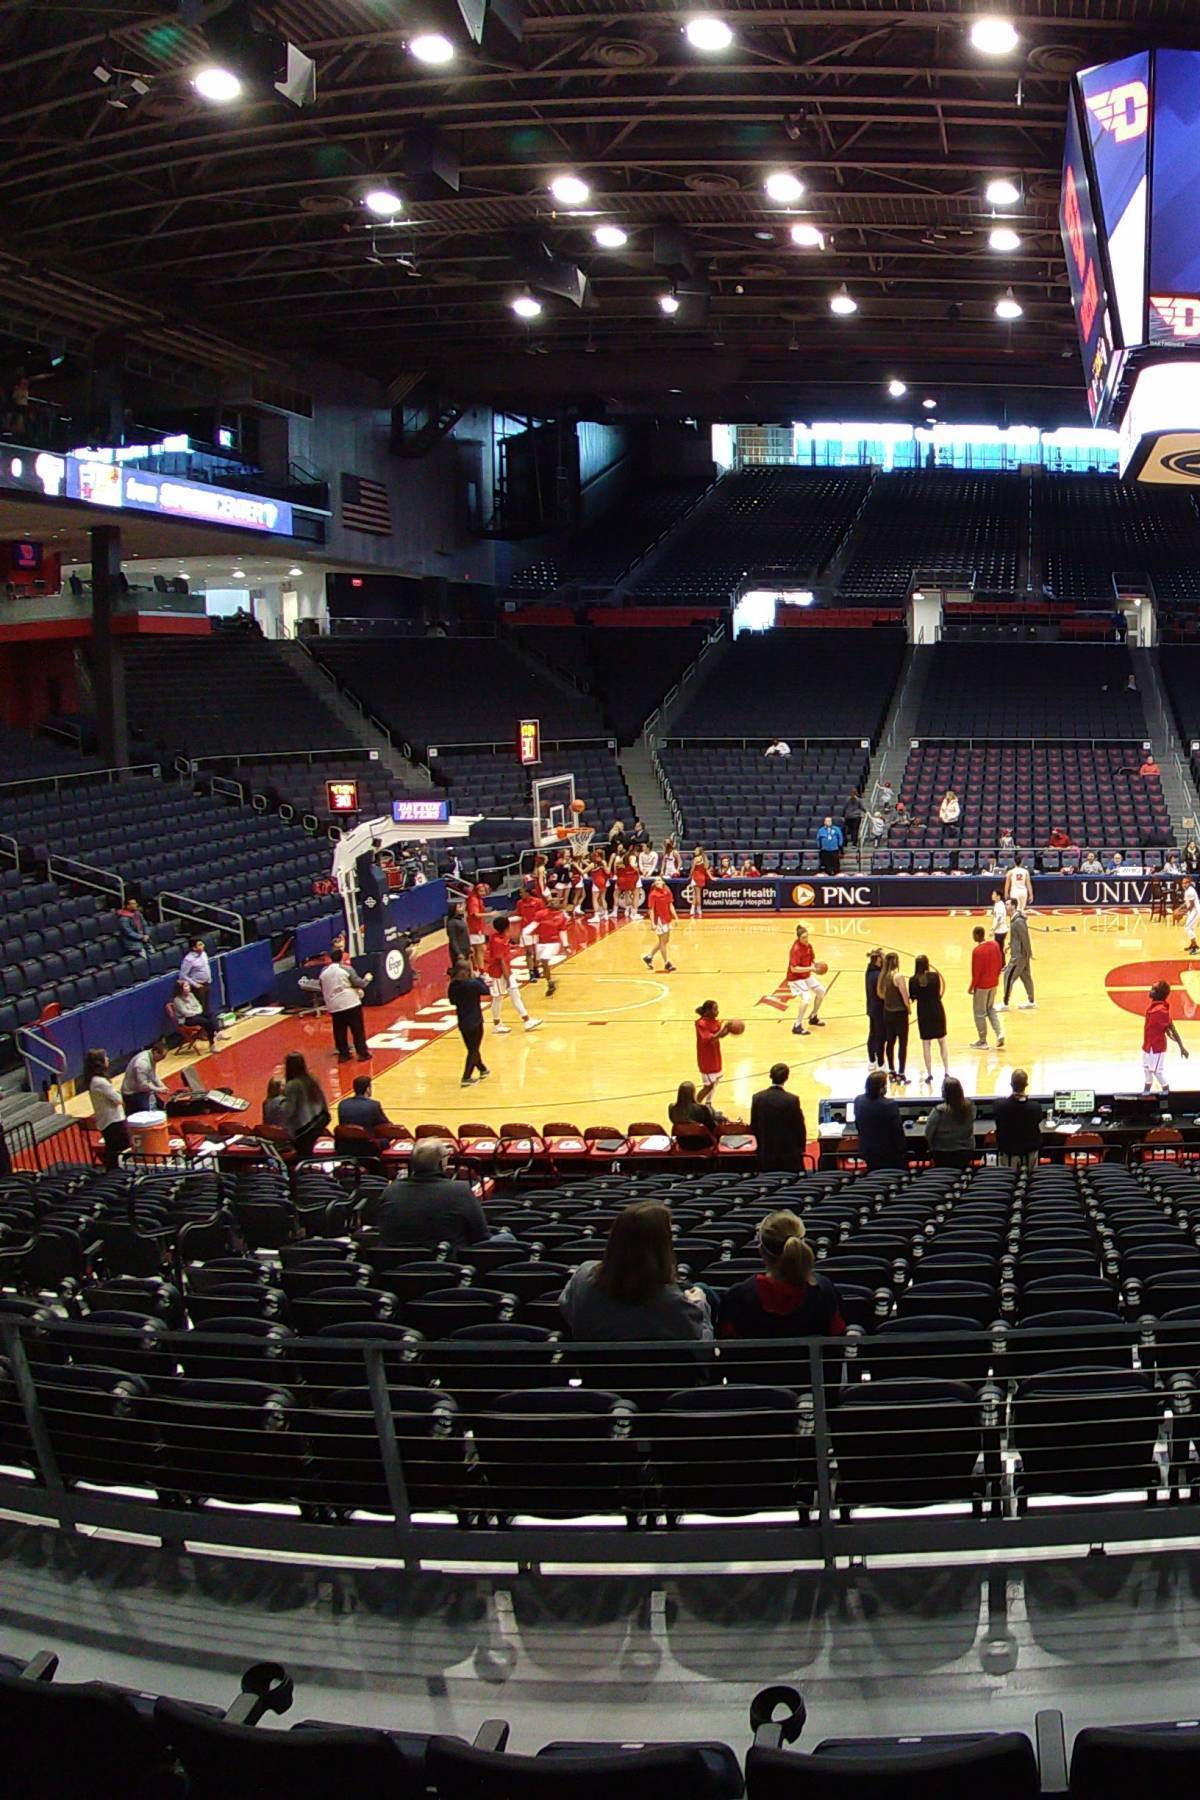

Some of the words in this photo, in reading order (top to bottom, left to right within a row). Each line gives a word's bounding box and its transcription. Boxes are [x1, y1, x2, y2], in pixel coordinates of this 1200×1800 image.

[702, 887, 742, 899] Premier
[743, 886, 776, 898] Health
[821, 886, 871, 905] PNC
[724, 898, 744, 907] Valley
[745, 898, 772, 907] Hospital
